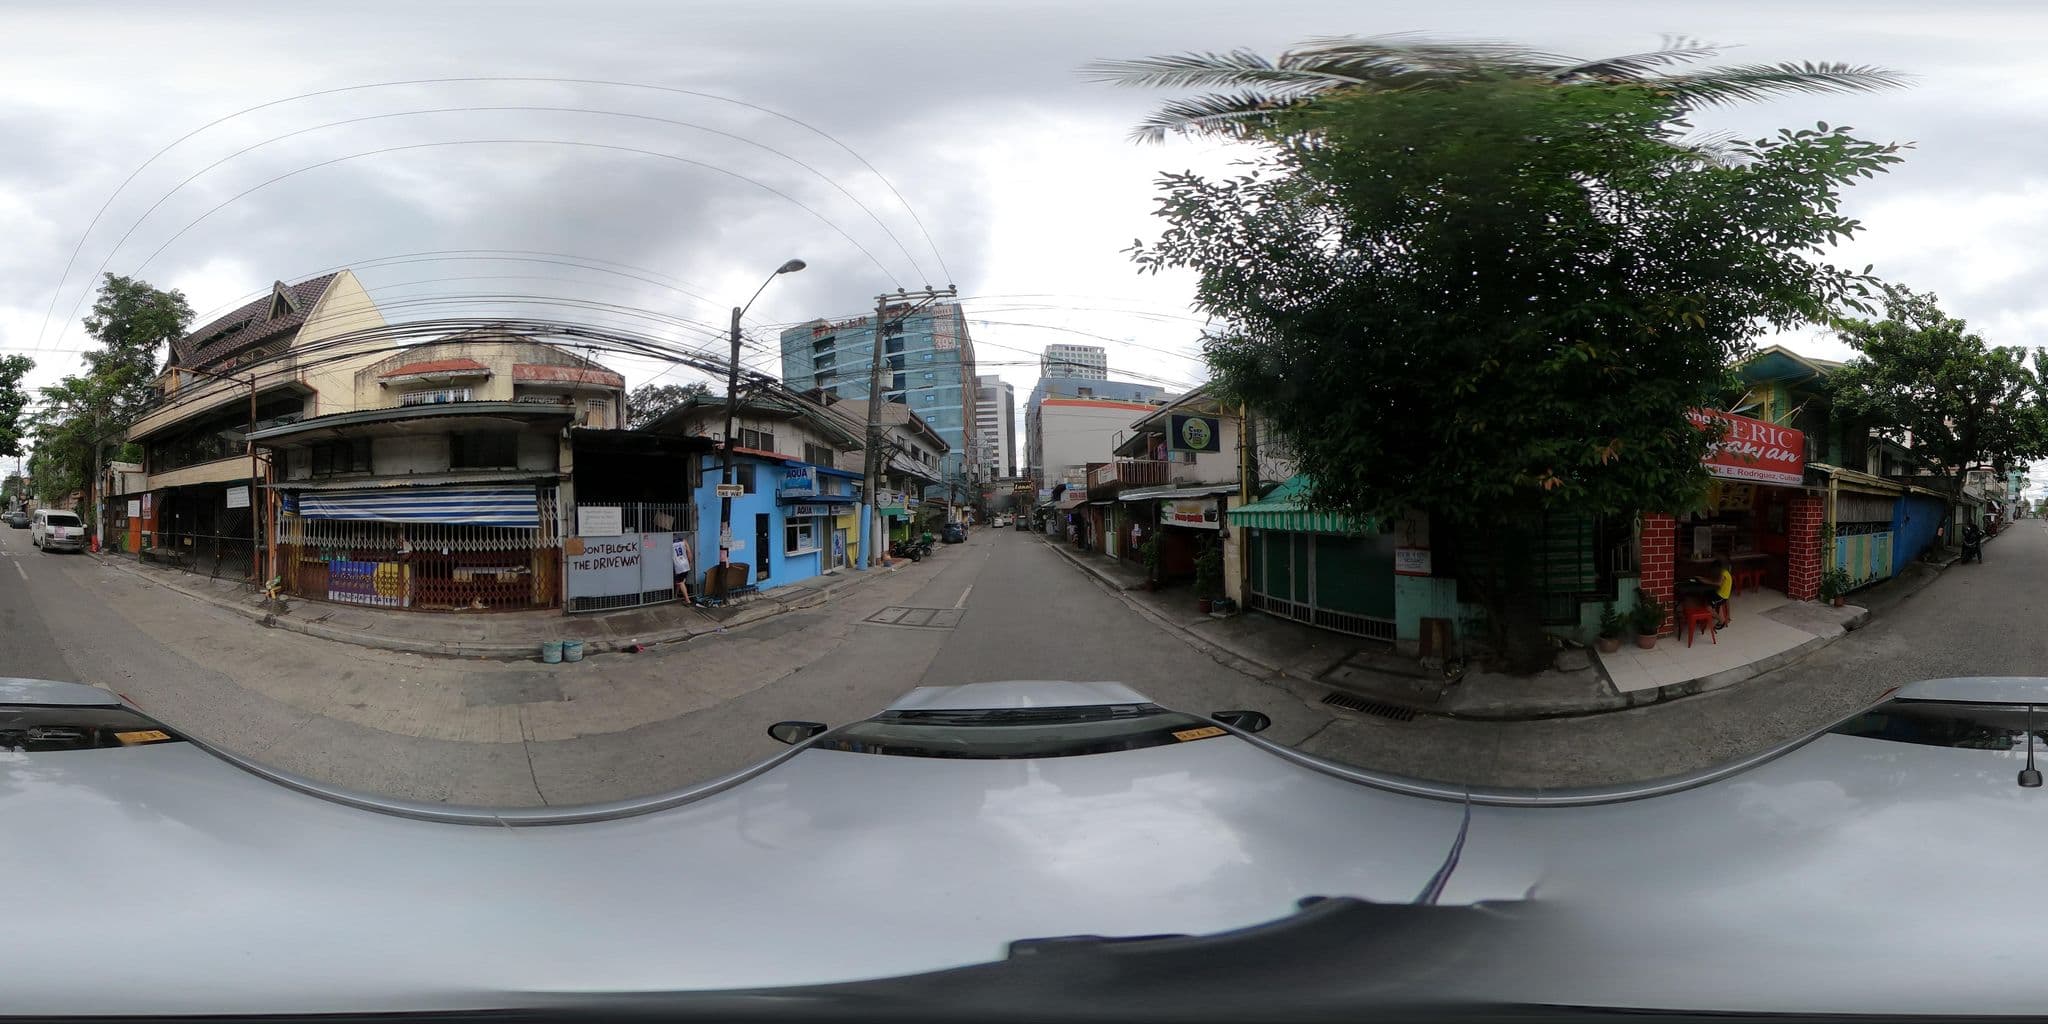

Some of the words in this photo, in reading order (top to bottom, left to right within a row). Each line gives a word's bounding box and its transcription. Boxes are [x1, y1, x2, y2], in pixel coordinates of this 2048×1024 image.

[786, 468, 808, 478] AQUA
[797, 505, 813, 515] AQUA
[606, 542, 638, 555] BLOCK
[574, 561, 591, 571] THE
[593, 554, 640, 570] DRIVEWAY
